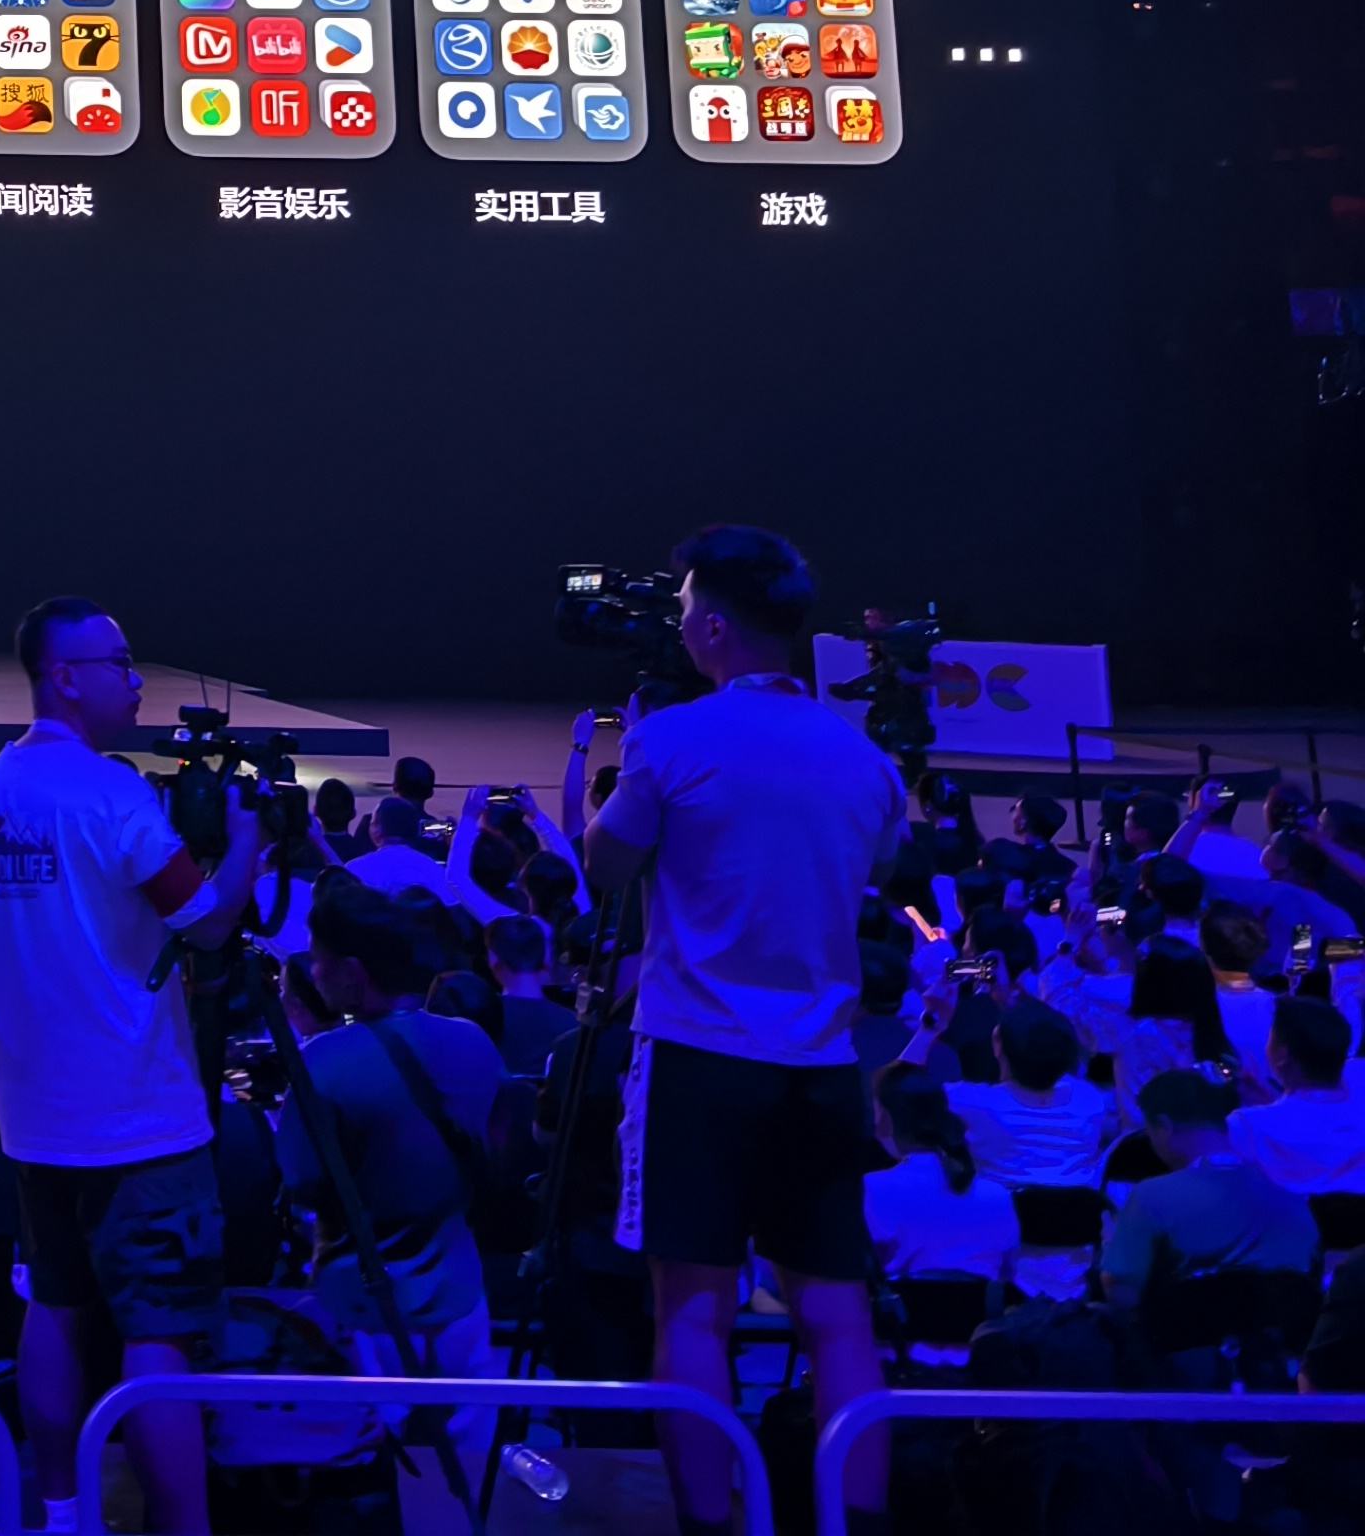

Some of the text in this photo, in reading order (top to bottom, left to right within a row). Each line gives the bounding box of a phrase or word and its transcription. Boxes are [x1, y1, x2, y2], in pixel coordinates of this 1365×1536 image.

[1, 84, 50, 103] 搜狐
[261, 90, 300, 126] 听
[762, 96, 810, 119] 三国志
[219, 186, 351, 220] 影音娱乐
[475, 189, 606, 223] 实用工具
[760, 192, 829, 226] 游戏
[14, 853, 55, 882] LIFE
